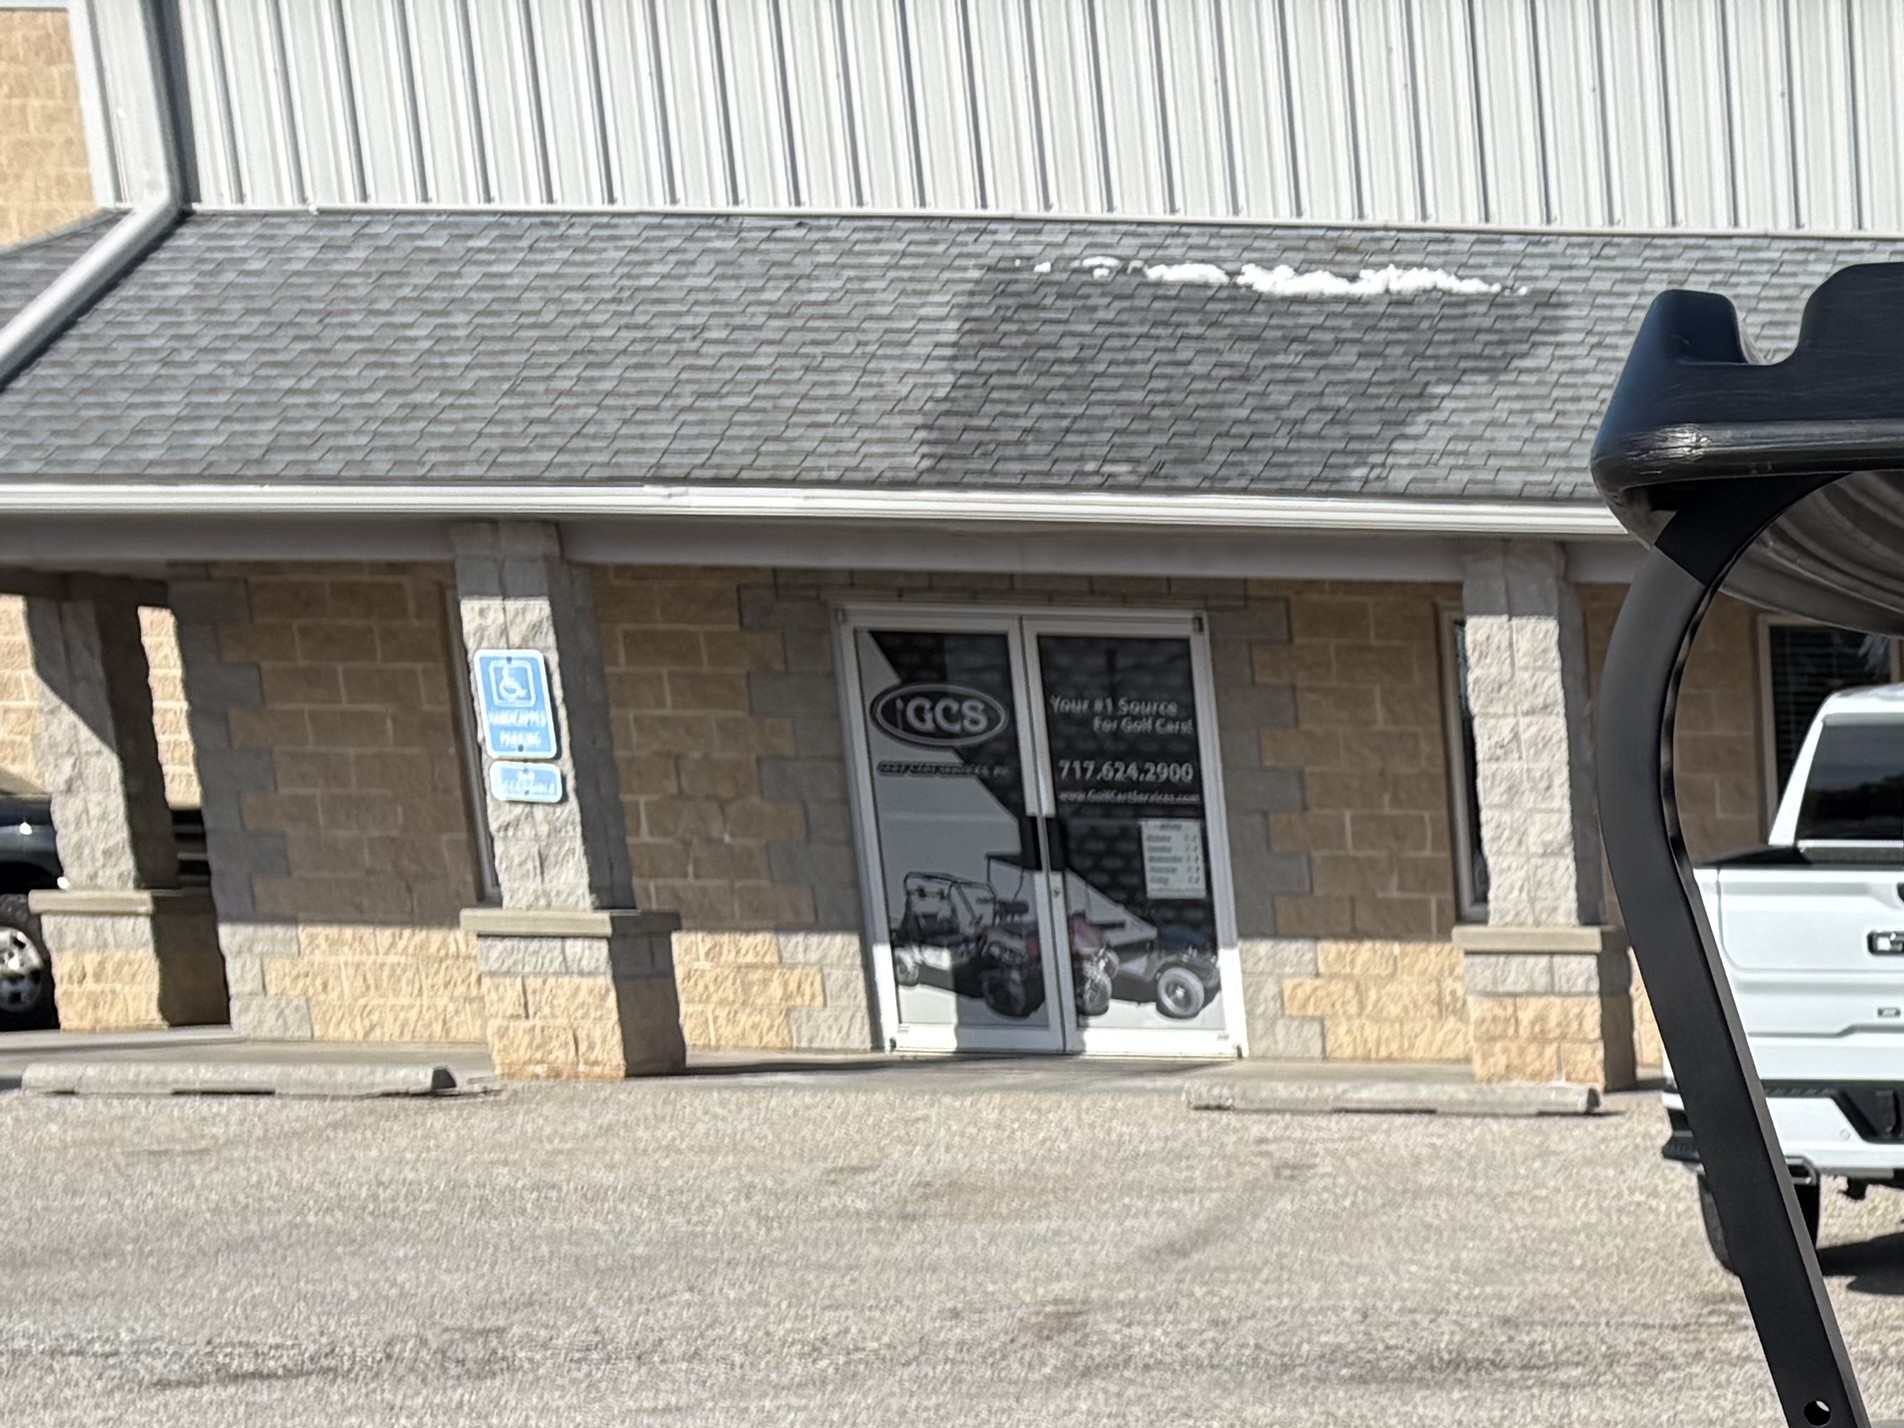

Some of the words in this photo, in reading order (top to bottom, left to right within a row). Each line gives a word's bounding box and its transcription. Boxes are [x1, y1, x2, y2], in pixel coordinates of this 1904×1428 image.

[906, 697, 988, 733] GCS
[1050, 695, 1090, 716] Your
[1117, 697, 1178, 717] Source
[1057, 759, 1195, 783] 717.624.2900
